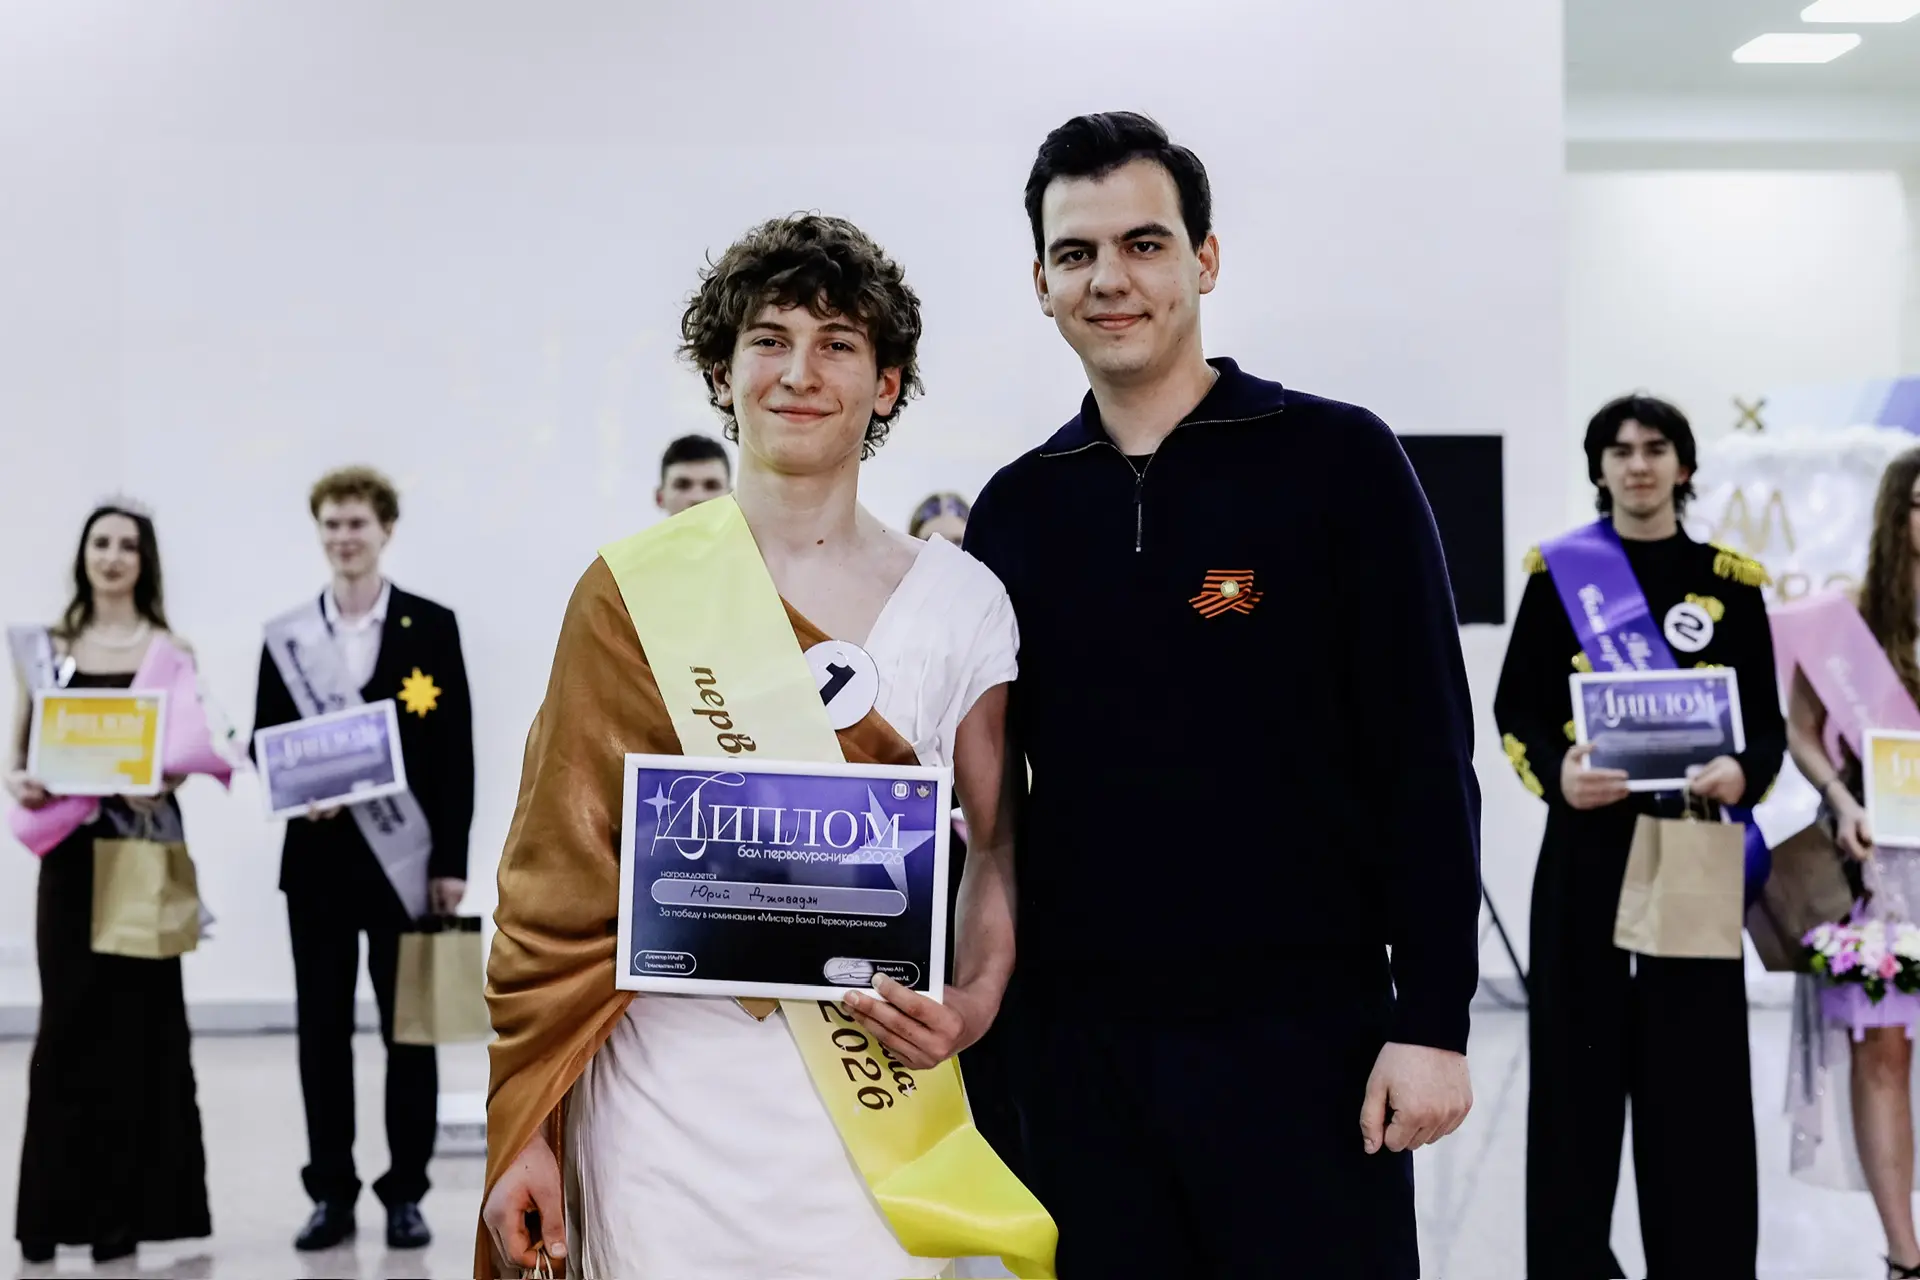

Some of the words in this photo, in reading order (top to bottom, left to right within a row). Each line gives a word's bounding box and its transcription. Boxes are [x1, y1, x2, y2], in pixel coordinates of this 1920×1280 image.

[1672, 611, 1704, 643] 2
[819, 662, 856, 707] 1
[689, 665, 756, 759] перв
[737, 844, 761, 859] бал
[764, 848, 860, 864] первокурсников
[862, 851, 903, 865] 2026
[660, 871, 717, 880] награждается
[690, 884, 731, 902] Юрий
[659, 906, 670, 917] За
[671, 908, 701, 920] победу
[708, 912, 756, 921] номинации
[757, 912, 794, 926] «Мистер
[817, 915, 887, 928] Первокурсников»
[817, 1000, 894, 1110] 2026
